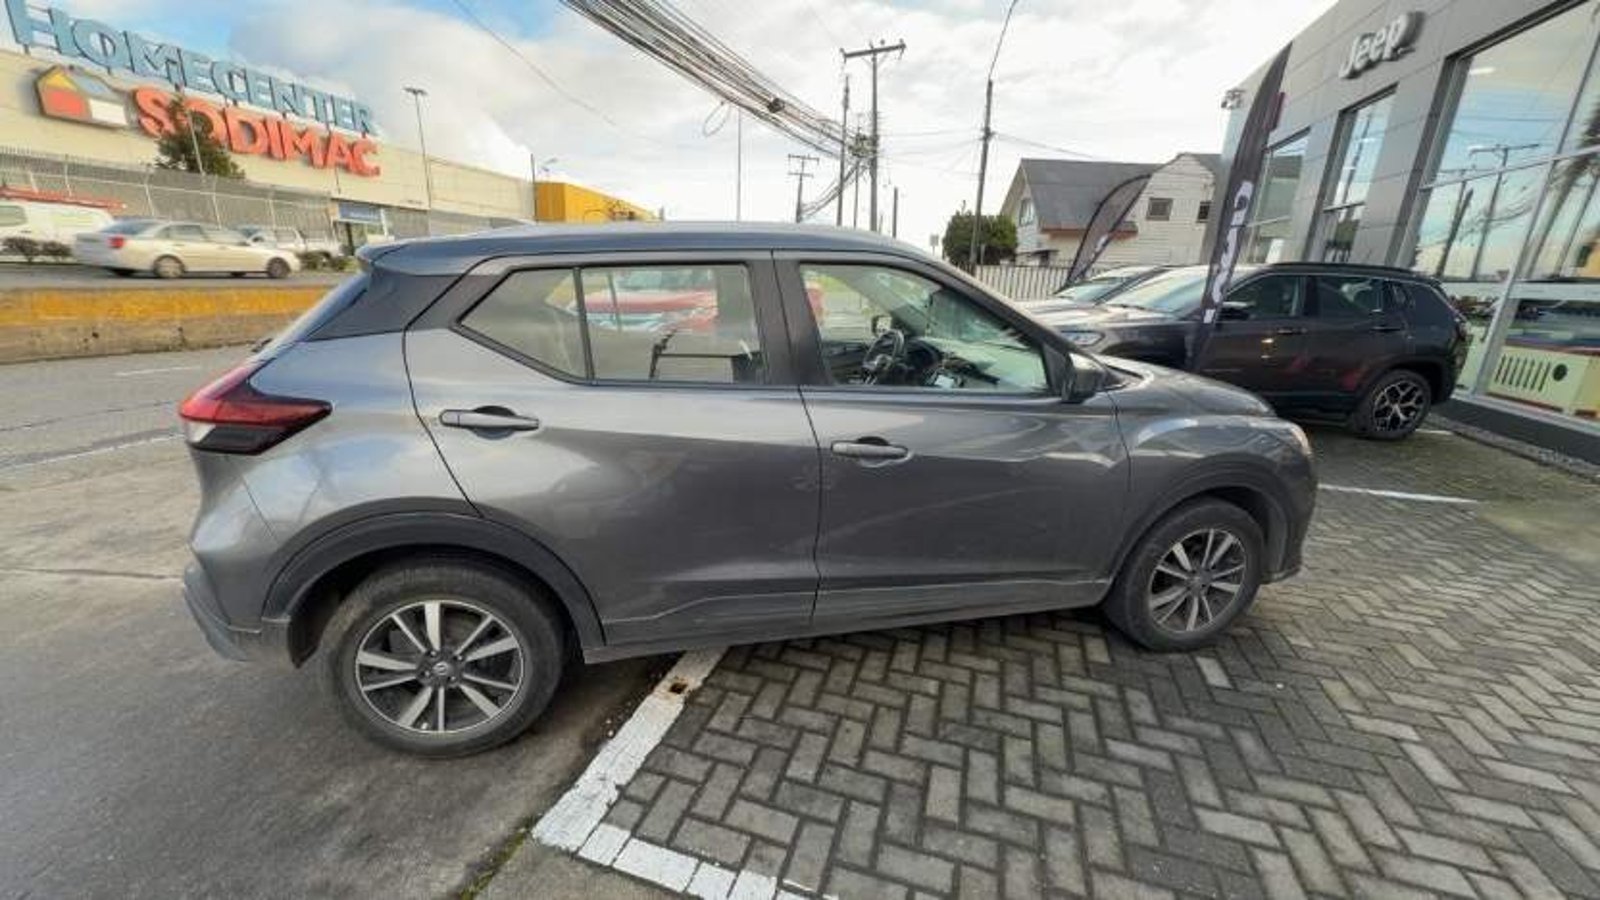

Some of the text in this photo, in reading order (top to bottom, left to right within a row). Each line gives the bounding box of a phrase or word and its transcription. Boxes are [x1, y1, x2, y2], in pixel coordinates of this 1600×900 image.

[4, 0, 377, 135] HOMECENTER
[1339, 12, 1418, 79] Jeep
[133, 86, 381, 177] SODIMAC
